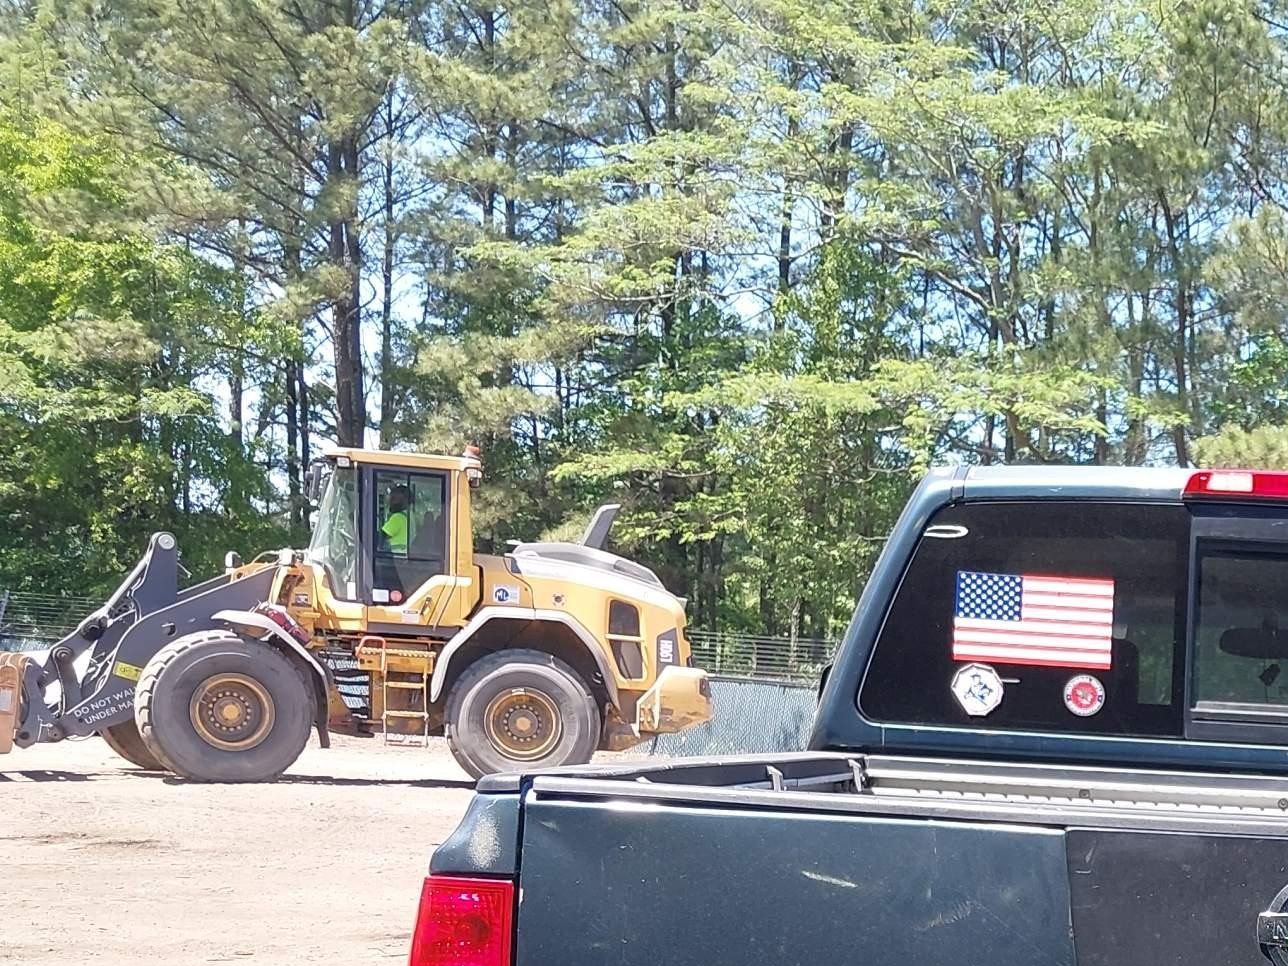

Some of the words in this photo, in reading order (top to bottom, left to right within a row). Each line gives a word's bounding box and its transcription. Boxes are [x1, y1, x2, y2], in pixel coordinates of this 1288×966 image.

[660, 639, 673, 662] L90H
[73, 706, 90, 718] DO
[90, 696, 112, 711] NOT
[112, 686, 137, 701] WAL
[84, 706, 118, 725] UNDER
